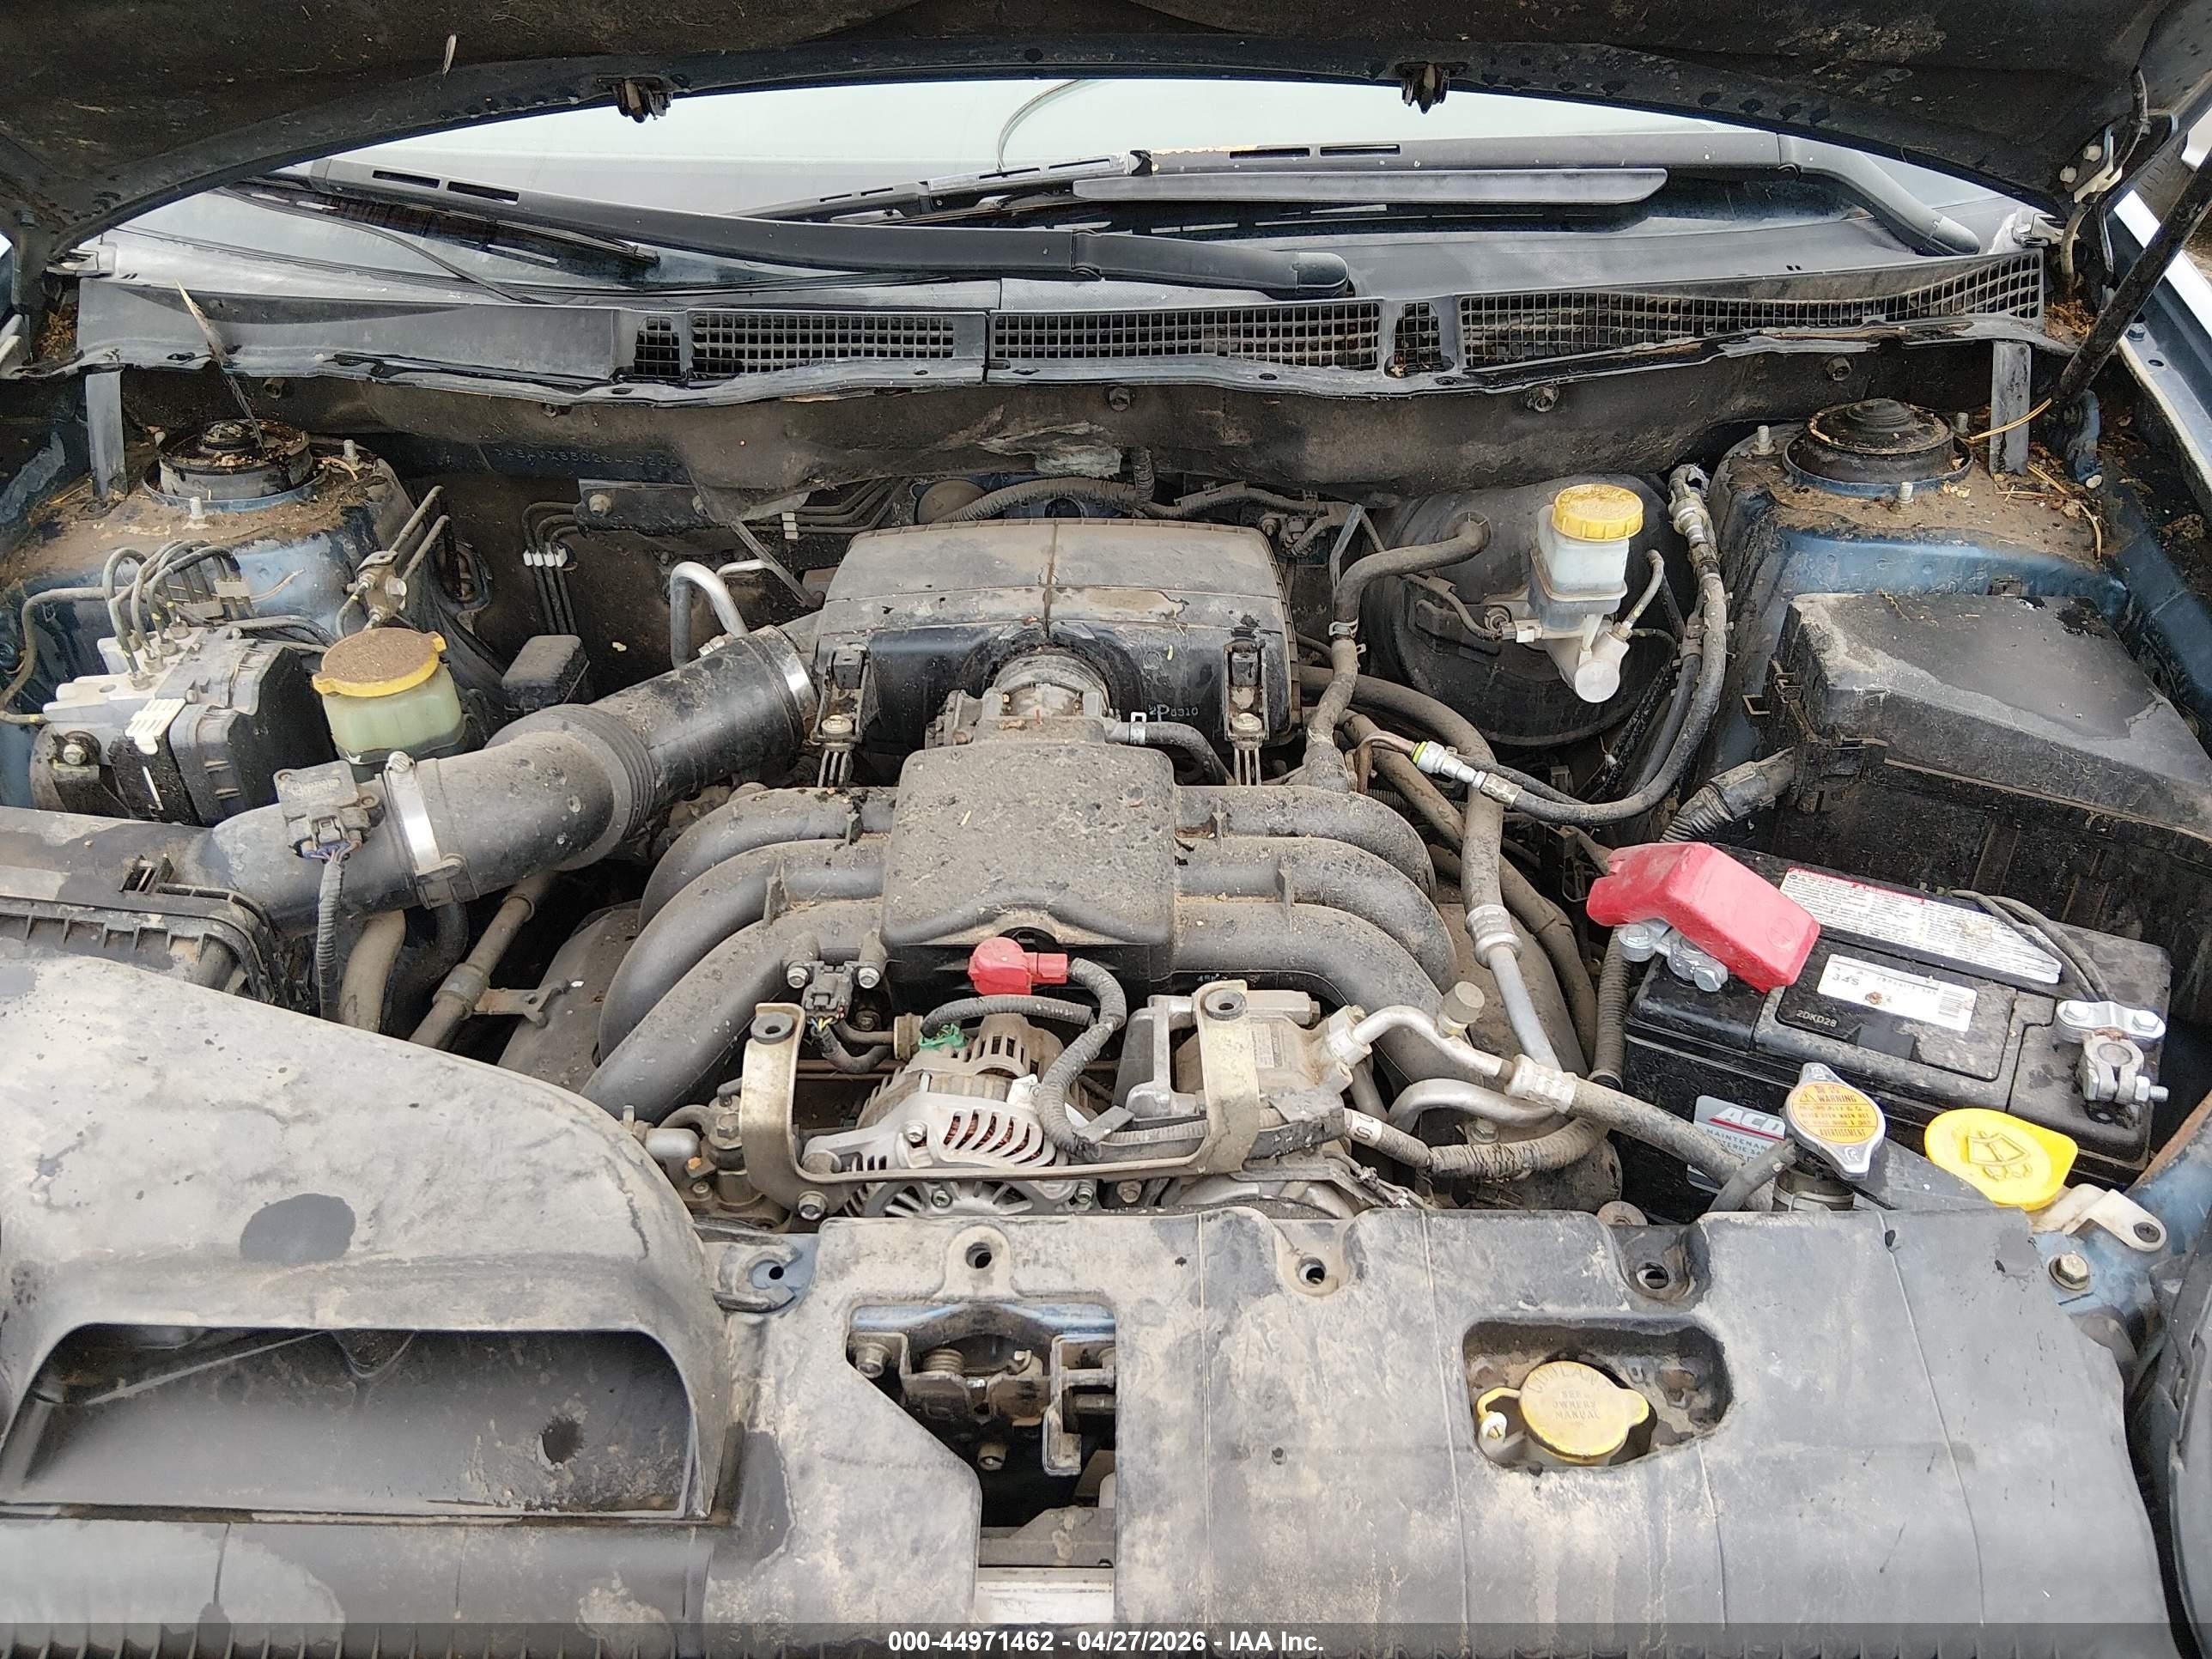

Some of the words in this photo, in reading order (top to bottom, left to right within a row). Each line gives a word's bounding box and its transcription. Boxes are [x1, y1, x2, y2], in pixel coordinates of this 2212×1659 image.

[1818, 1094, 1857, 1103] WARNING
[1707, 1128, 1768, 1151] MAINTENAN
[1555, 1410, 1601, 1419] MANUAL
